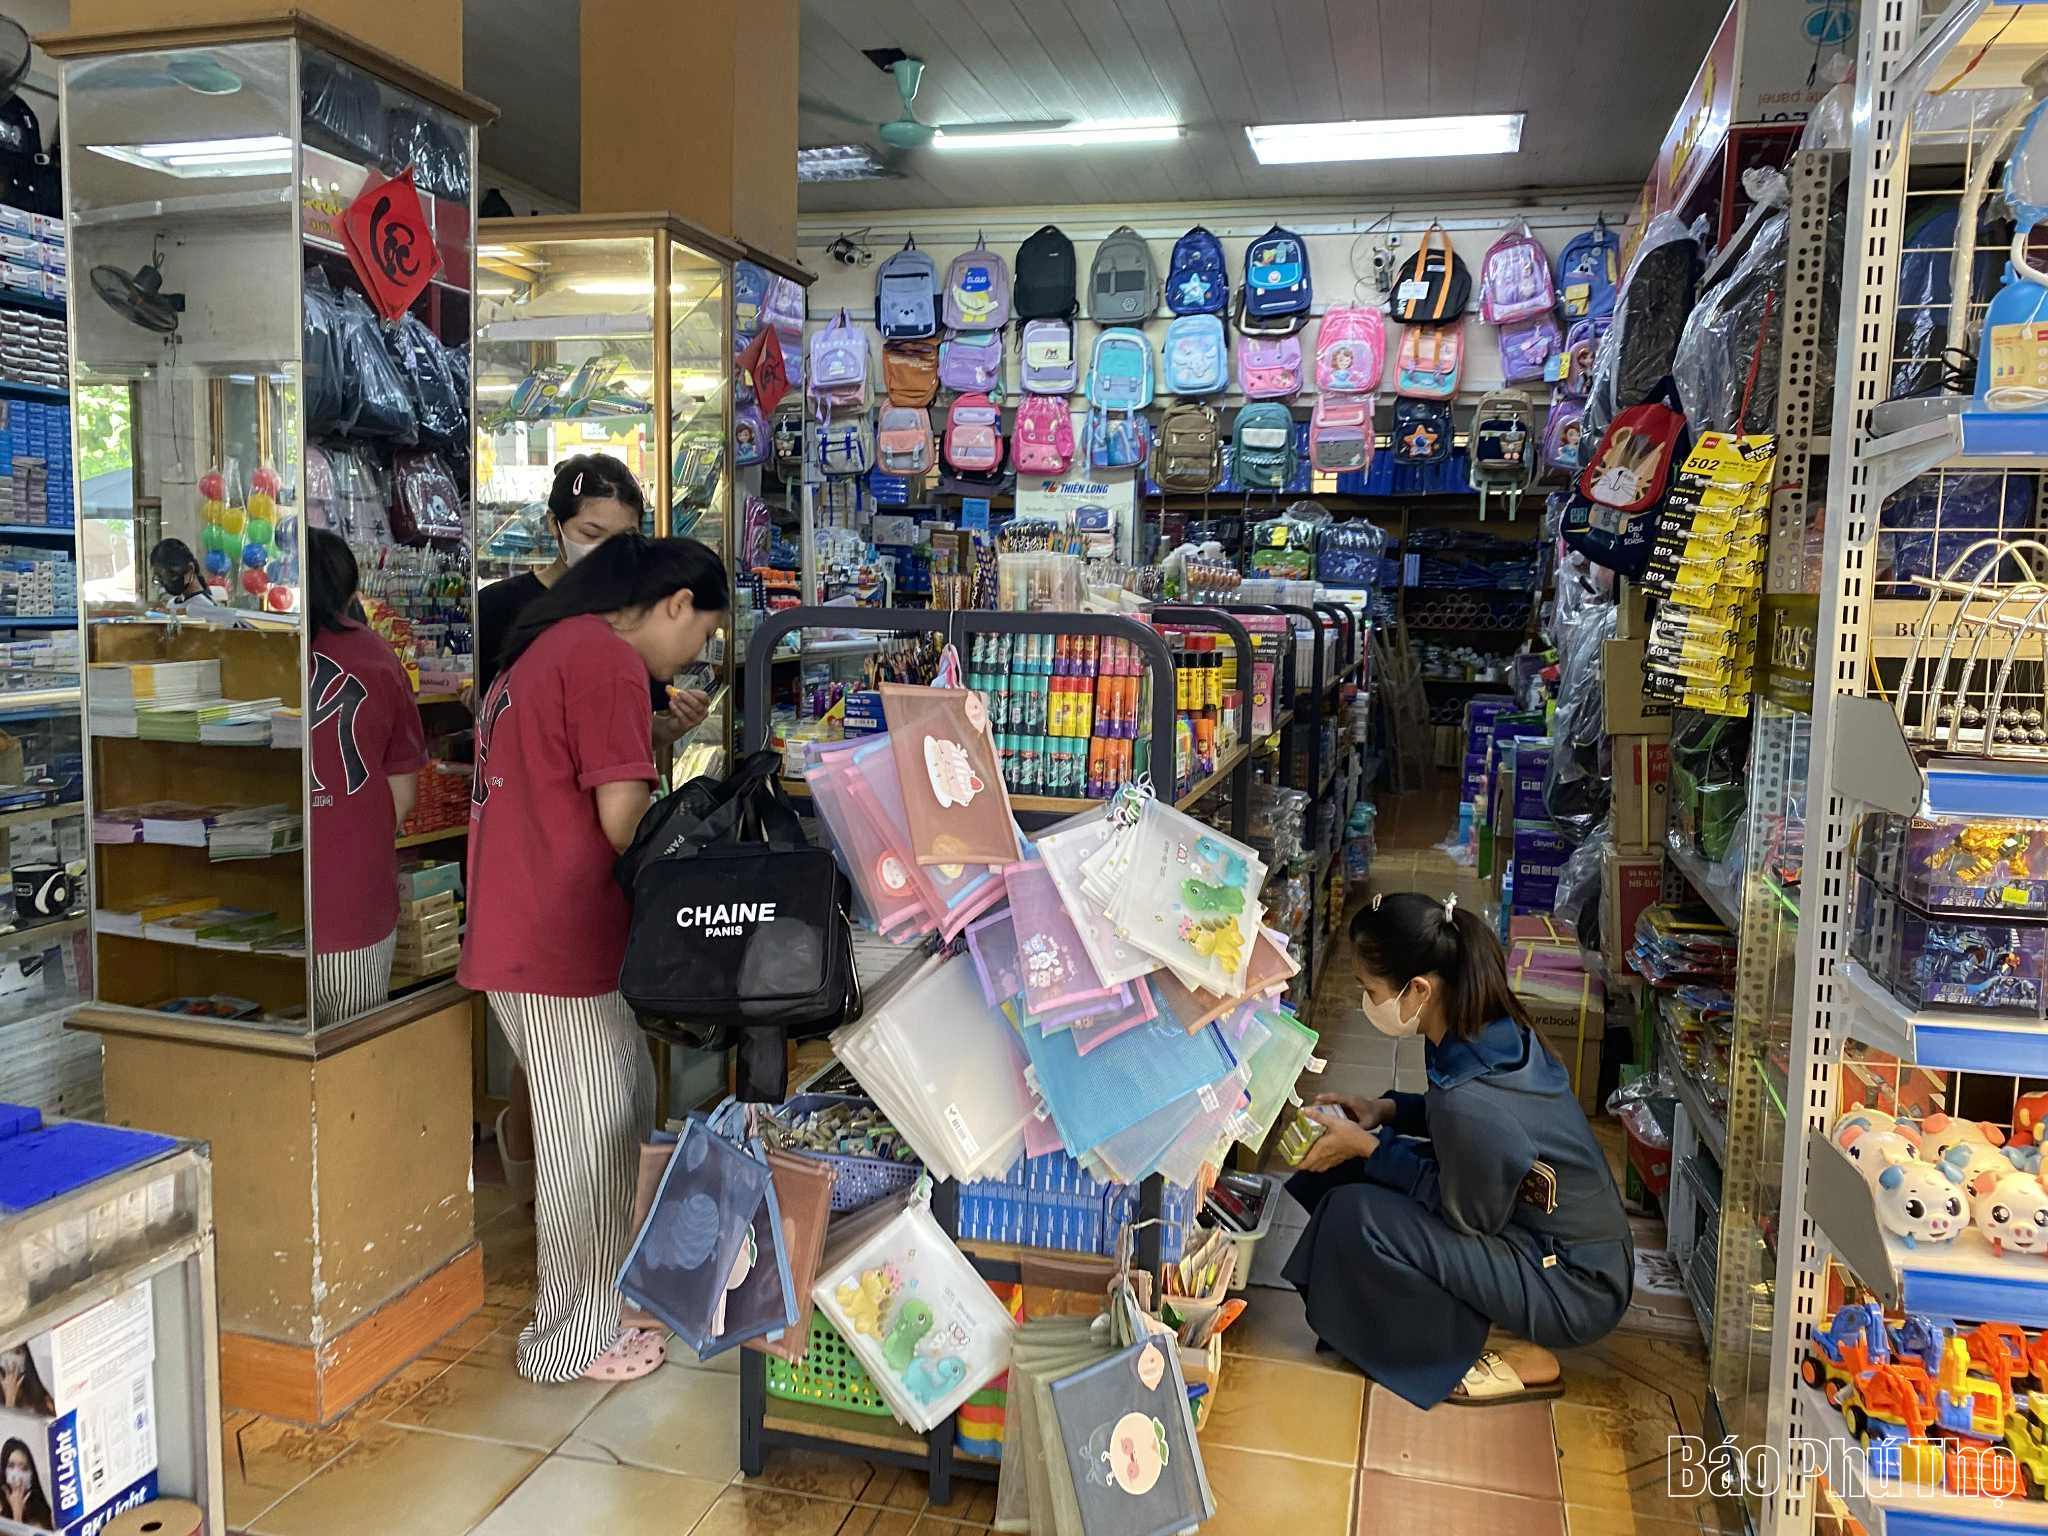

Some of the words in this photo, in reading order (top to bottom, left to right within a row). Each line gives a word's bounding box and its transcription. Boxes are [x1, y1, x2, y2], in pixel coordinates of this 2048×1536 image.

[1687, 457, 1720, 471] 502
[1060, 482, 1085, 494] THIÊN
[1085, 484, 1110, 494] LONG
[663, 834, 685, 856] PAN
[676, 902, 777, 928] CHAINE
[705, 925, 743, 938] PANIS
[56, 1428, 78, 1477] Light
[60, 1478, 78, 1511] BK
